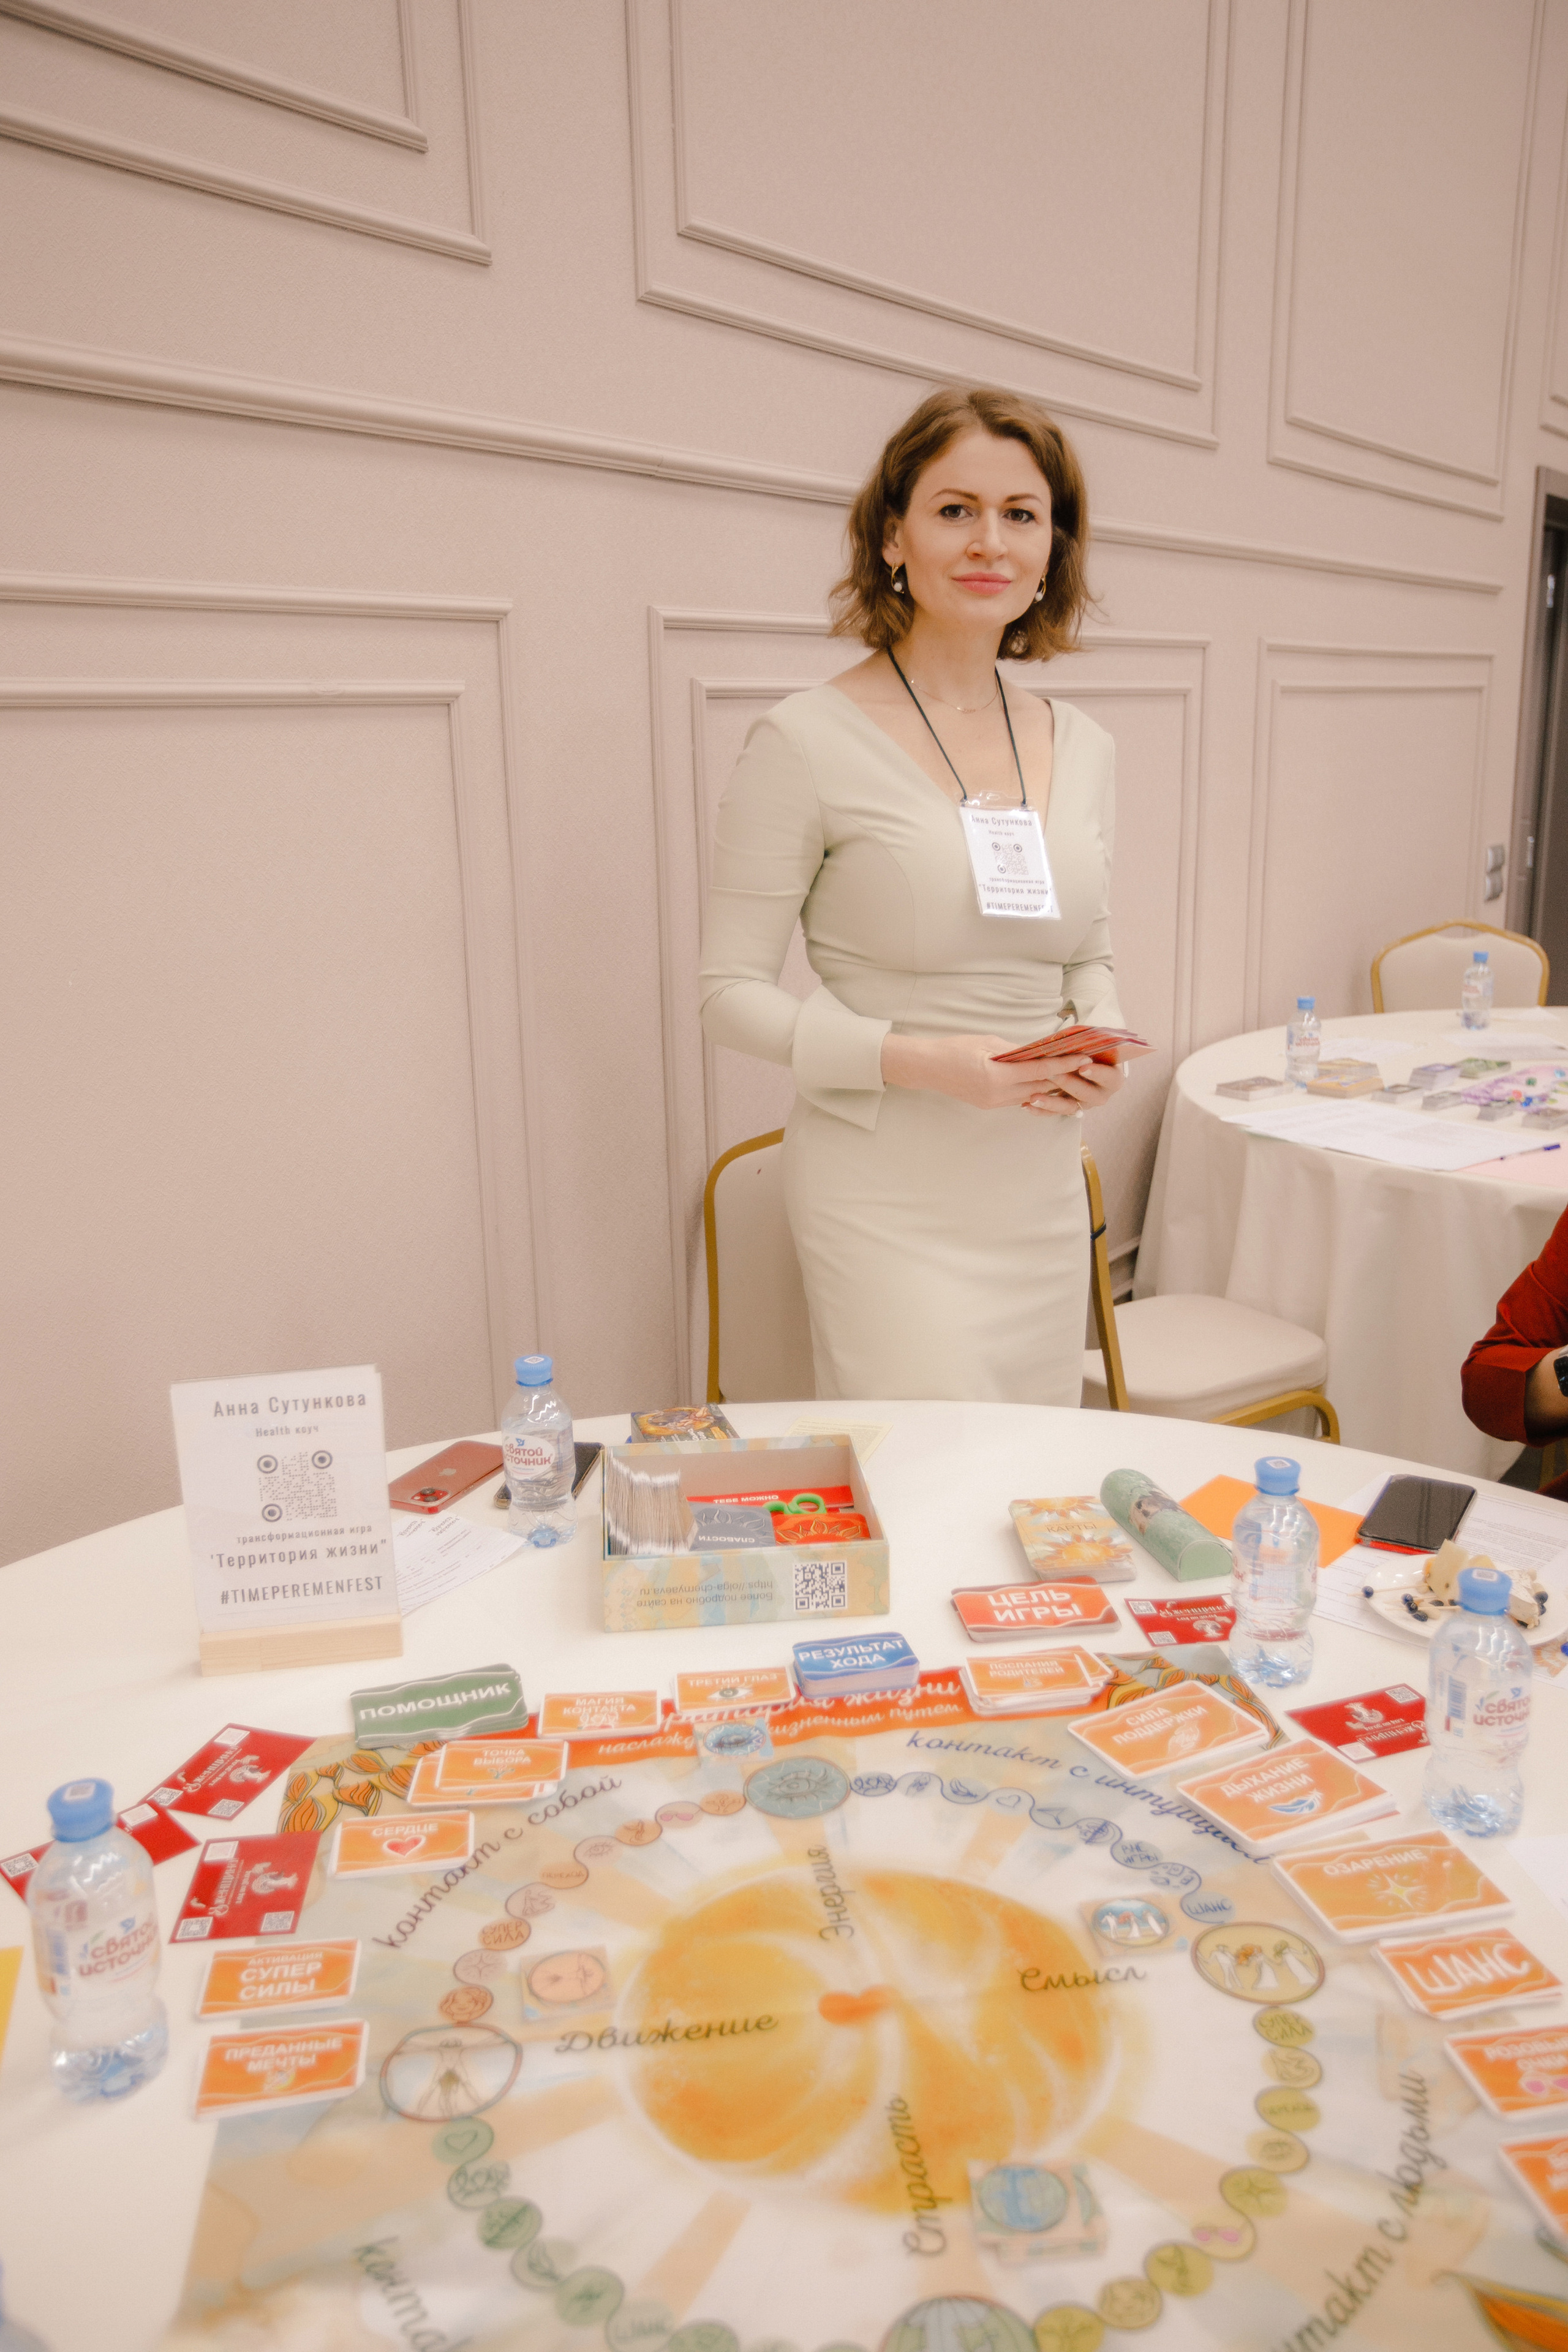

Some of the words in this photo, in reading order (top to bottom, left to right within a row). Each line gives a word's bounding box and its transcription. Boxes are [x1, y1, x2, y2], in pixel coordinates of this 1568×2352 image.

[971, 814, 989, 824] Анна
[992, 817, 1032, 827] Сутункова
[213, 1398, 260, 1418] Анна
[268, 1393, 367, 1414] Сутункова
[255, 1426, 291, 1438] Health
[295, 1425, 320, 1436] коуч
[349, 1525, 372, 1536] игра
[1046, 1523, 1098, 1532] КАРТЫ
[698, 1534, 755, 1544] СЛАБОСТИ
[221, 1575, 383, 1605] #TIMEPEREMENFEST
[685, 1593, 737, 1606] подробно
[740, 1592, 773, 1601] Более
[987, 1589, 1072, 1608] ЦЕЛЬ
[636, 1598, 666, 1610] сайте
[993, 1604, 1082, 1622] ИГРЫ
[798, 1640, 904, 1662] РЕЗУЛЬТАТ
[829, 1653, 886, 1670] ХОДА
[989, 1659, 1058, 1670] ПОСЛАНИЯ
[989, 1665, 1065, 1677] РОДИТЕЛЕЙ
[688, 1676, 740, 1687] ТРЕТИЙ
[744, 1673, 778, 1684] ГЛАЗ
[359, 1682, 511, 1721] ПОМОЩНИК
[563, 1703, 636, 1715] КОНТАКТА
[576, 1697, 625, 1706] МАГИЯ
[890, 1703, 963, 1722] путем
[1125, 1706, 1172, 1726] СИЛА
[1112, 1705, 1207, 1745] ПОДДЕРЖКИ
[473, 1755, 531, 1766] ВЫБОРА
[906, 1730, 1061, 1770] контакт
[1069, 1766, 1090, 1777] с
[1219, 1757, 1310, 1799] ДЫХАНИЕ
[1245, 1773, 1314, 1804] ЖИЗНИ
[372, 1823, 439, 1838] СЕРДЦЕ
[371, 1841, 501, 1949] контакт
[503, 1826, 524, 1841] с
[527, 1774, 623, 1827] собой
[1323, 1849, 1428, 1876] ОЗАРЕНИЕ
[808, 1844, 856, 1941] Энергия
[1186, 1898, 1232, 1915] ШАНС
[481, 1921, 523, 1935] СУПЕР
[483, 1931, 524, 1945] СИЛА
[247, 1952, 323, 1966] АКТИВАЦИЯ
[239, 1961, 323, 1983] СУПЕР
[1401, 1943, 1531, 1995] ШАНС
[1019, 1964, 1147, 1994] Смысл
[239, 1978, 315, 2000] СИЛЫ
[554, 2013, 778, 2053] Движение
[224, 2037, 343, 2061] ПРЕДАННЫЕ
[246, 2054, 317, 2073] МЕЧТЫ
[1374, 2068, 1448, 2218] людьми
[885, 2093, 952, 2258] Страсть
